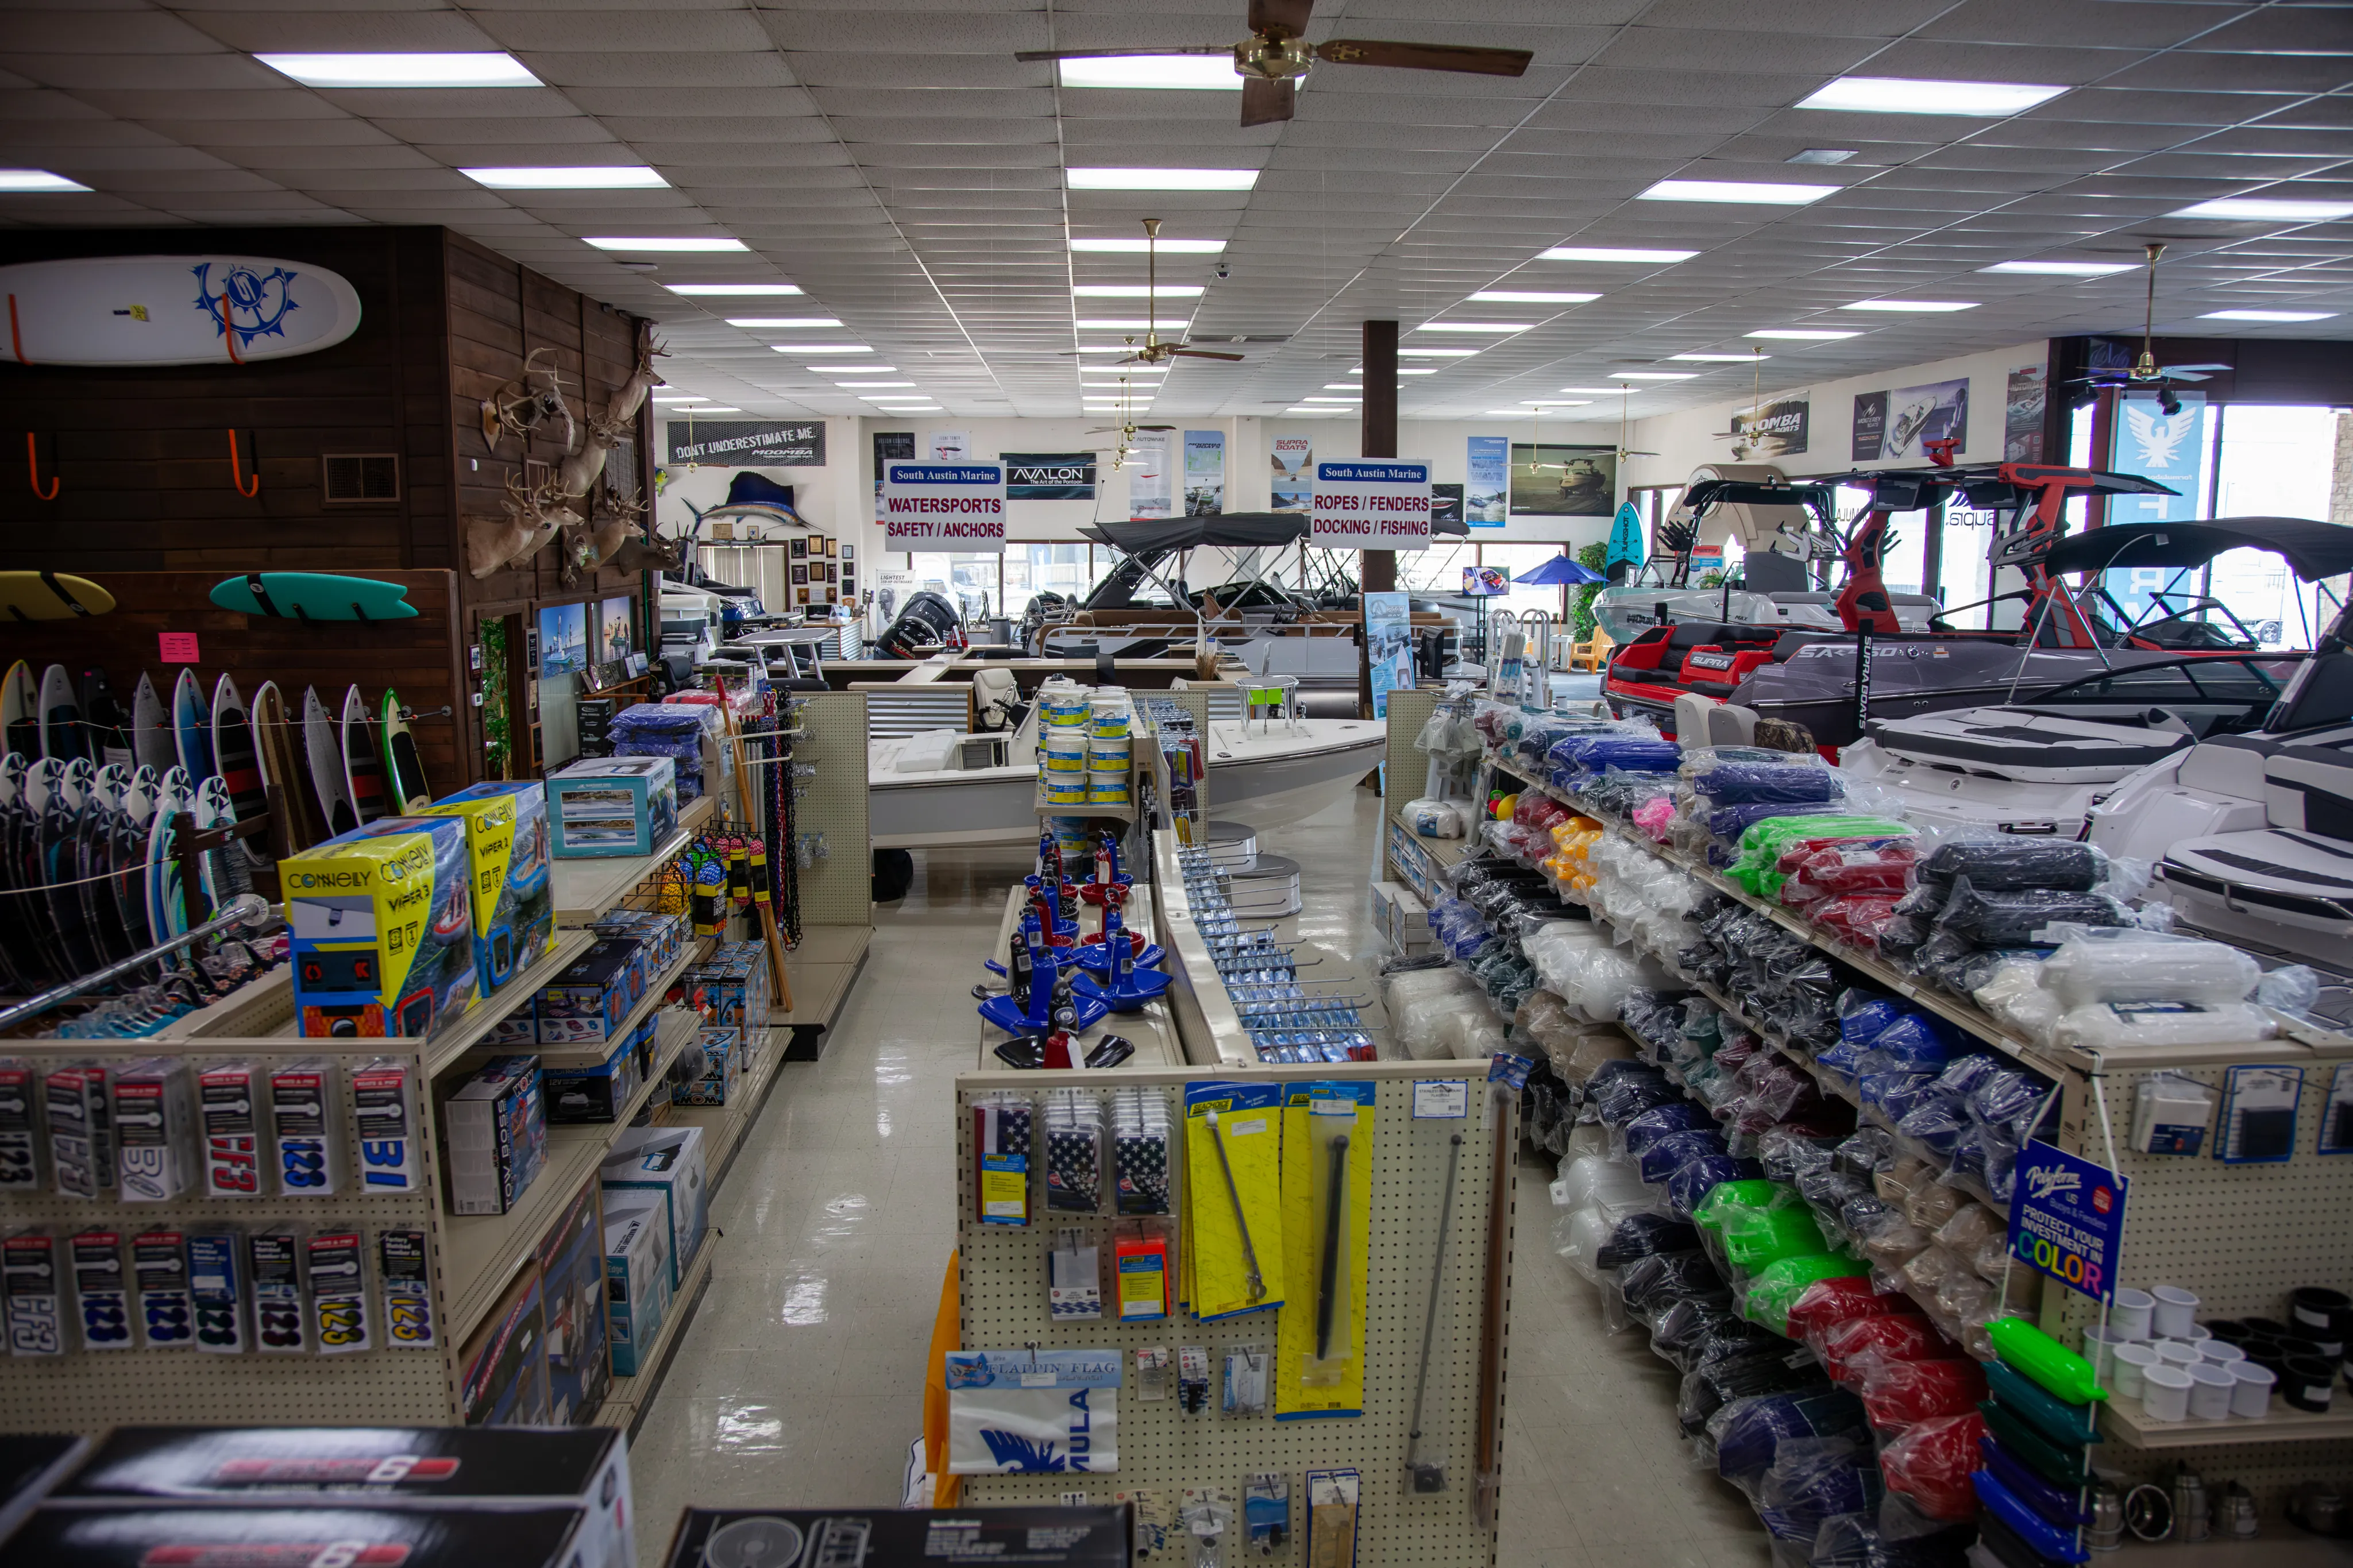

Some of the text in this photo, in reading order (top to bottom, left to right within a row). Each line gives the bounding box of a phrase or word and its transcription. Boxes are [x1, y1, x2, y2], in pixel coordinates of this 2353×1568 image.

[676, 427, 816, 459] DON'T UNDERESTIMATE ME.
[897, 470, 995, 480] South Austin Marine
[1014, 468, 1083, 480] AVALON
[1326, 468, 1421, 478] South Austin Marine
[1471, 472, 1502, 481] WAVE
[888, 498, 1001, 513] WATERSPORTS
[1314, 495, 1429, 512] ROPES / FENDERS
[888, 522, 1004, 538] SAFETY / ANCHORS
[1314, 519, 1428, 535] DOCKING / FISHING
[904, 634, 919, 646] YAMAHA
[1691, 655, 1729, 669] SUPRA
[1859, 635, 1872, 730] SUPRA BOATS
[479, 836, 510, 860] VIPER 2
[381, 844, 433, 883] CONNELLY
[289, 871, 371, 888] CONNELLY
[386, 888, 421, 914] VIPER
[715, 896, 726, 906] TUBE
[715, 906, 726, 916] ROPE
[682, 921, 692, 933] TUBE
[682, 931, 693, 941] ROPE
[512, 1069, 533, 1098] WOW
[1193, 1100, 1230, 1113] SEACHOICE
[497, 1099, 513, 1211] TOW BOSS
[281, 1142, 326, 1188] 123
[2025, 1164, 2082, 1199] Polyform
[2065, 1191, 2078, 1206] US
[2022, 1203, 2105, 1253] PROTECT YOUR
[2078, 1209, 2108, 1232] Fenders
[623, 1228, 638, 1245] WAKESURF
[2020, 1215, 2104, 1265] INVESTMENT IN
[608, 1265, 623, 1274] Edge
[2018, 1231, 2103, 1295] COLOR
[319, 1300, 365, 1345] 123
[389, 1297, 431, 1341] 123
[986, 1362, 1117, 1374] FLAPPIN' FLAG
[367, 1455, 421, 1483] 6
